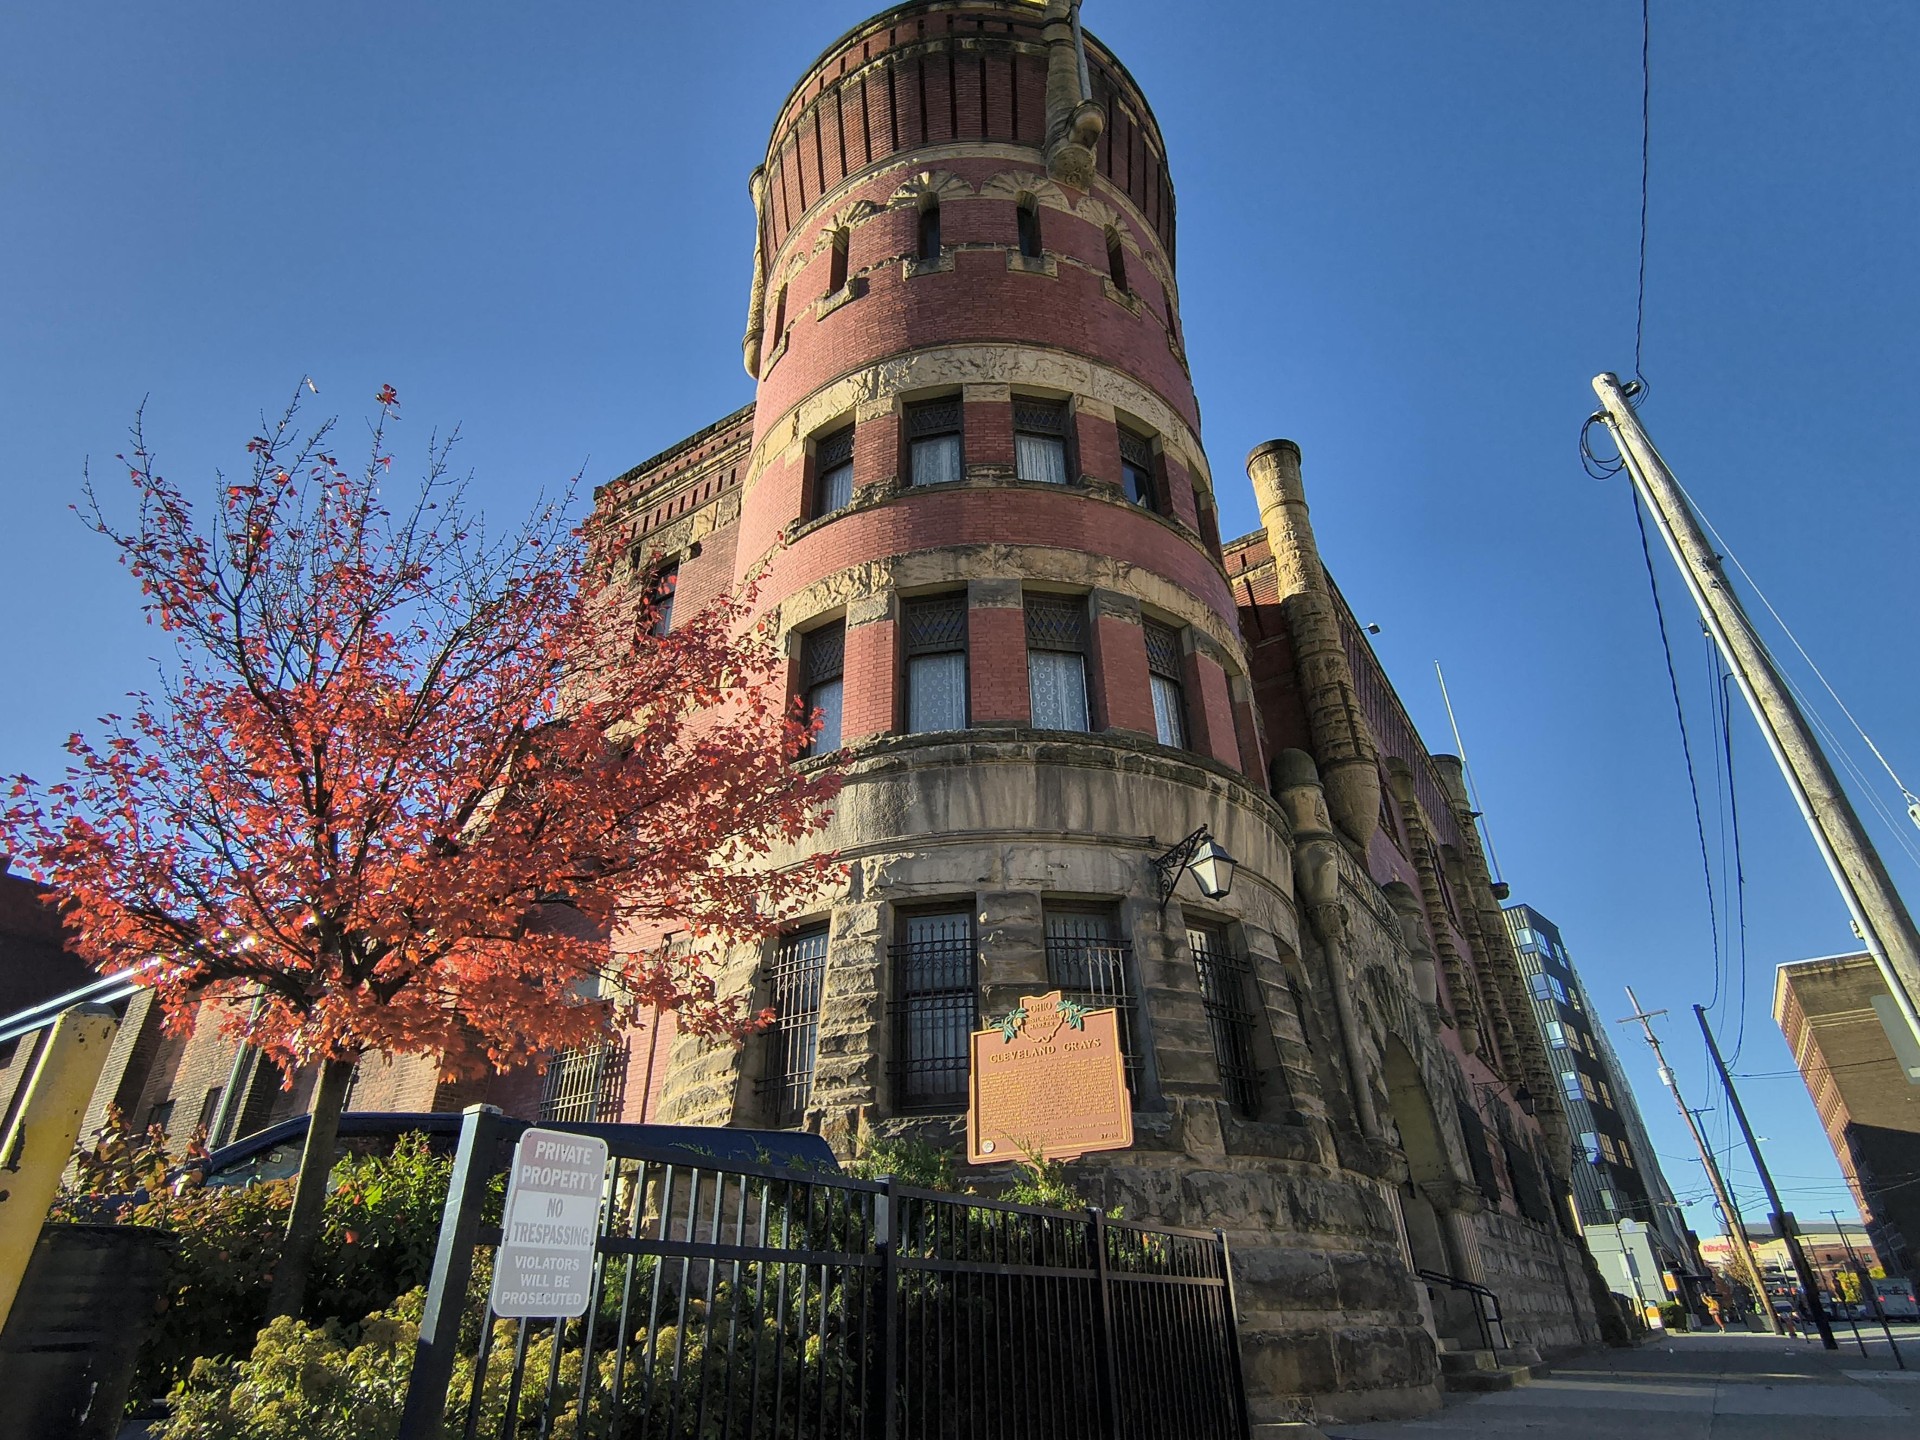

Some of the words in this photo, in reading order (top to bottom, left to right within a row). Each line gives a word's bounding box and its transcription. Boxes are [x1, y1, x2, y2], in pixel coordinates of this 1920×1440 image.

[1030, 1001, 1053, 1013] OHIO
[989, 1046, 1057, 1063] CLEVELAND
[1063, 1038, 1102, 1052] GRAYS
[534, 1141, 593, 1165] PRIVATE
[521, 1165, 599, 1191] PROPERTY
[546, 1198, 564, 1218] NO
[513, 1222, 590, 1246] TRESPASSING
[515, 1255, 580, 1271] VIOLATORS
[520, 1273, 549, 1287] WILL
[555, 1275, 571, 1288] BE
[501, 1291, 582, 1306] PROSECUTED
[1876, 1286, 1909, 1296] FedEx
